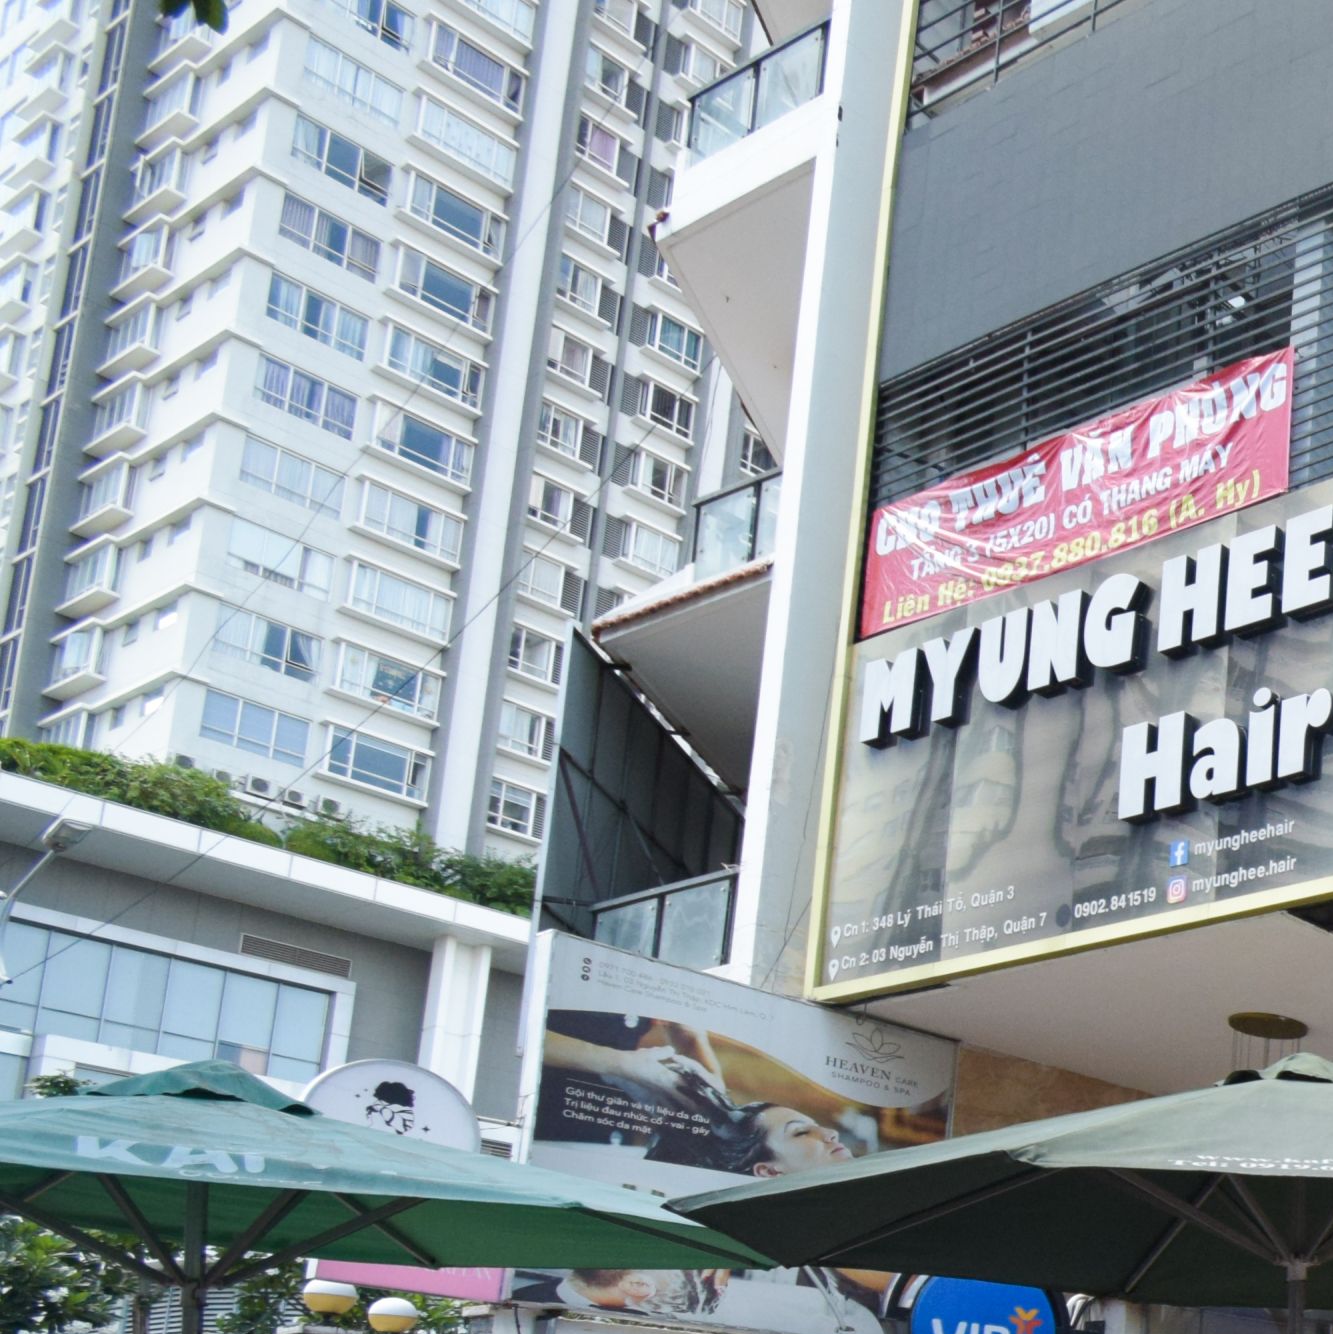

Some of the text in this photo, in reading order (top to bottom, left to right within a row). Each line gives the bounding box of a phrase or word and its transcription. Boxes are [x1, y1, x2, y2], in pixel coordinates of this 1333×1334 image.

[876, 501, 941, 558] CHO
[949, 453, 1046, 532] THUÊ
[986, 512, 1056, 557] (5X20)
[1063, 500, 1092, 532] CÓ
[1103, 468, 1172, 514] THANG
[1179, 441, 1233, 484] MÁY
[882, 590, 930, 625] Liên
[937, 574, 975, 608] Hệ:
[1169, 494, 1205, 530] (A.
[1215, 470, 1261, 513] Hy)
[859, 573, 1146, 745] MYUNG
[1118, 687, 1332, 822] Hair
[1193, 818, 1296, 857] myungheehair
[1074, 886, 1157, 920] 0902.841519
[1192, 856, 1297, 895] myunghee.hair
[843, 923, 859, 938] Cn
[872, 911, 895, 931] 348
[896, 906, 912, 928] Lý
[916, 898, 943, 922] Thái
[971, 888, 1004, 912] Quận
[1007, 885, 1015, 902] 3
[840, 954, 857, 971] Cn
[871, 946, 887, 964] 03
[889, 936, 934, 962] Nguyễn
[940, 930, 960, 951] Thị
[964, 923, 998, 950] Thập,
[1003, 916, 1032, 939] Quận
[1039, 912, 1048, 927] 7
[825, 1055, 892, 1081] HEAVEN
